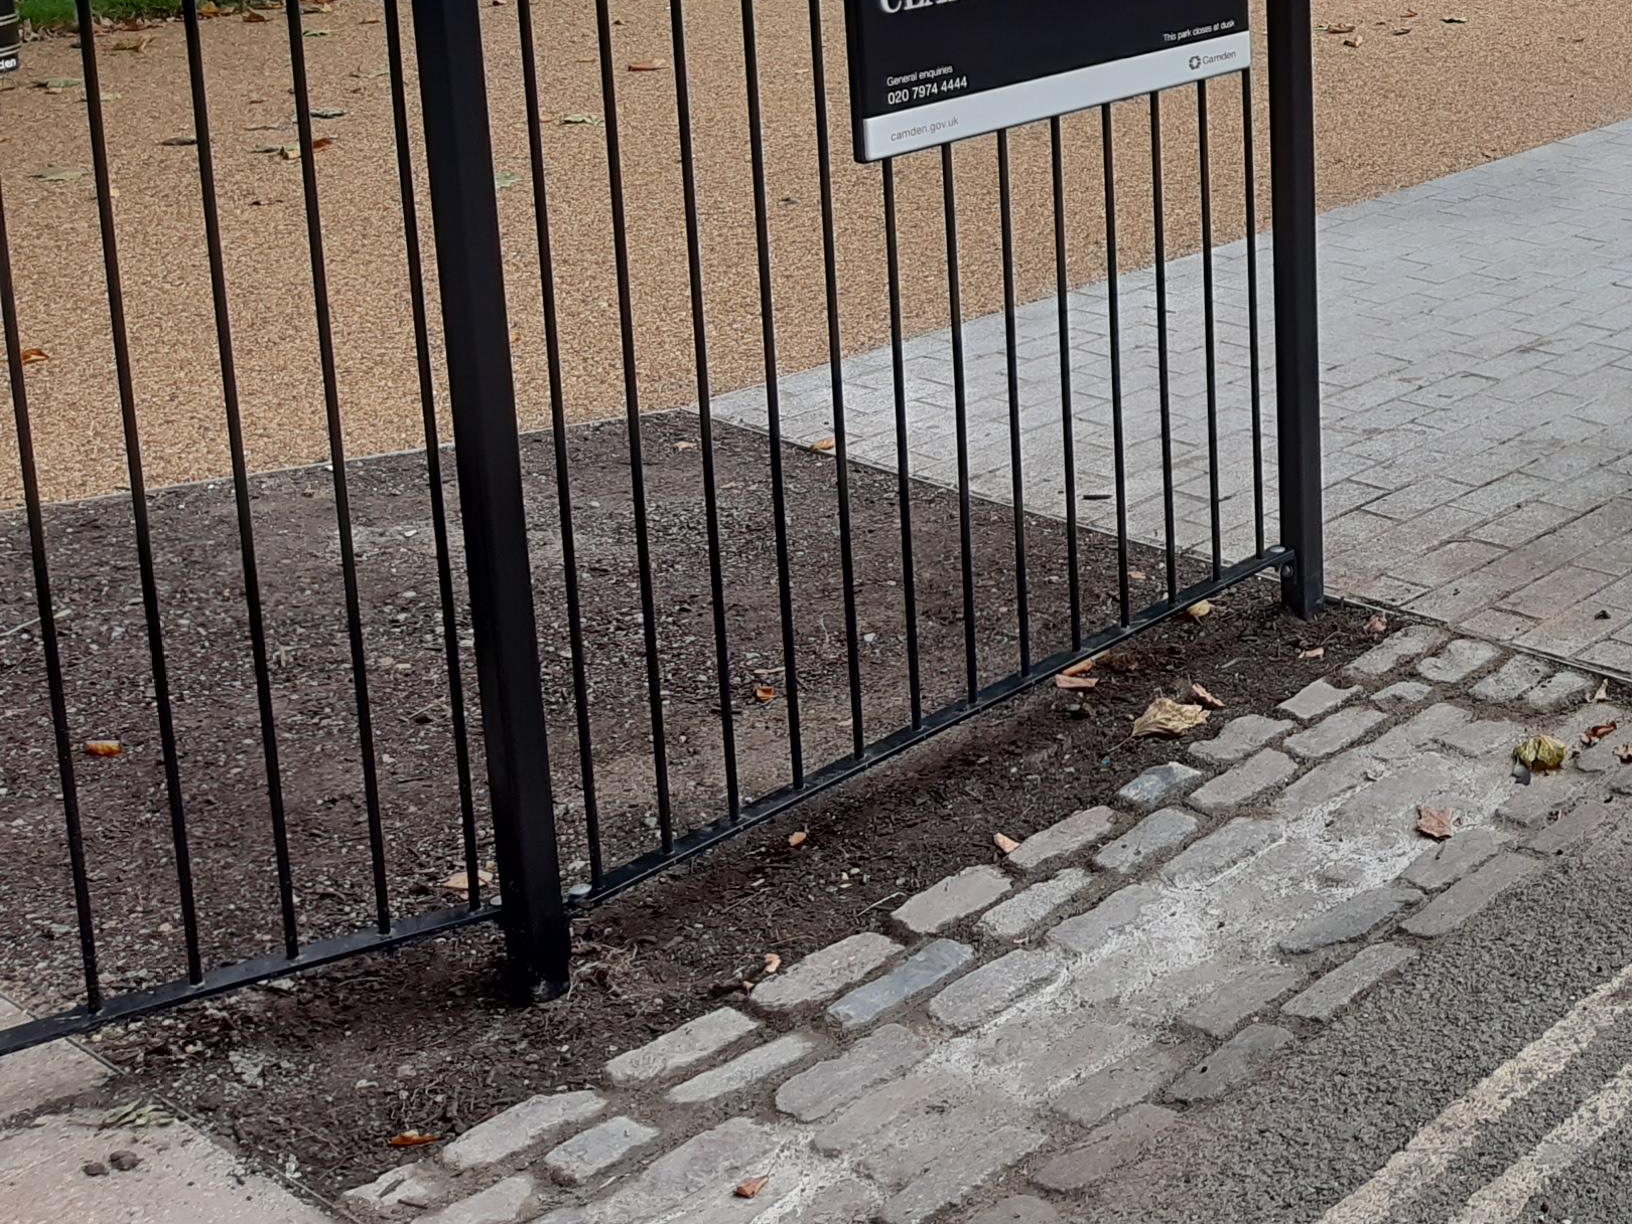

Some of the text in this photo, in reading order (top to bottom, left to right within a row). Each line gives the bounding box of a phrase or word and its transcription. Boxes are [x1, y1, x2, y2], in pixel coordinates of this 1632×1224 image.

[1163, 32, 1176, 41] This
[1177, 28, 1191, 40] park
[1220, 20, 1235, 30] dusk
[1202, 50, 1237, 65] Camden
[886, 65, 953, 86] General enquiries
[887, 76, 967, 105] 020 7974 4444
[890, 116, 959, 142] camden.gov.uk
